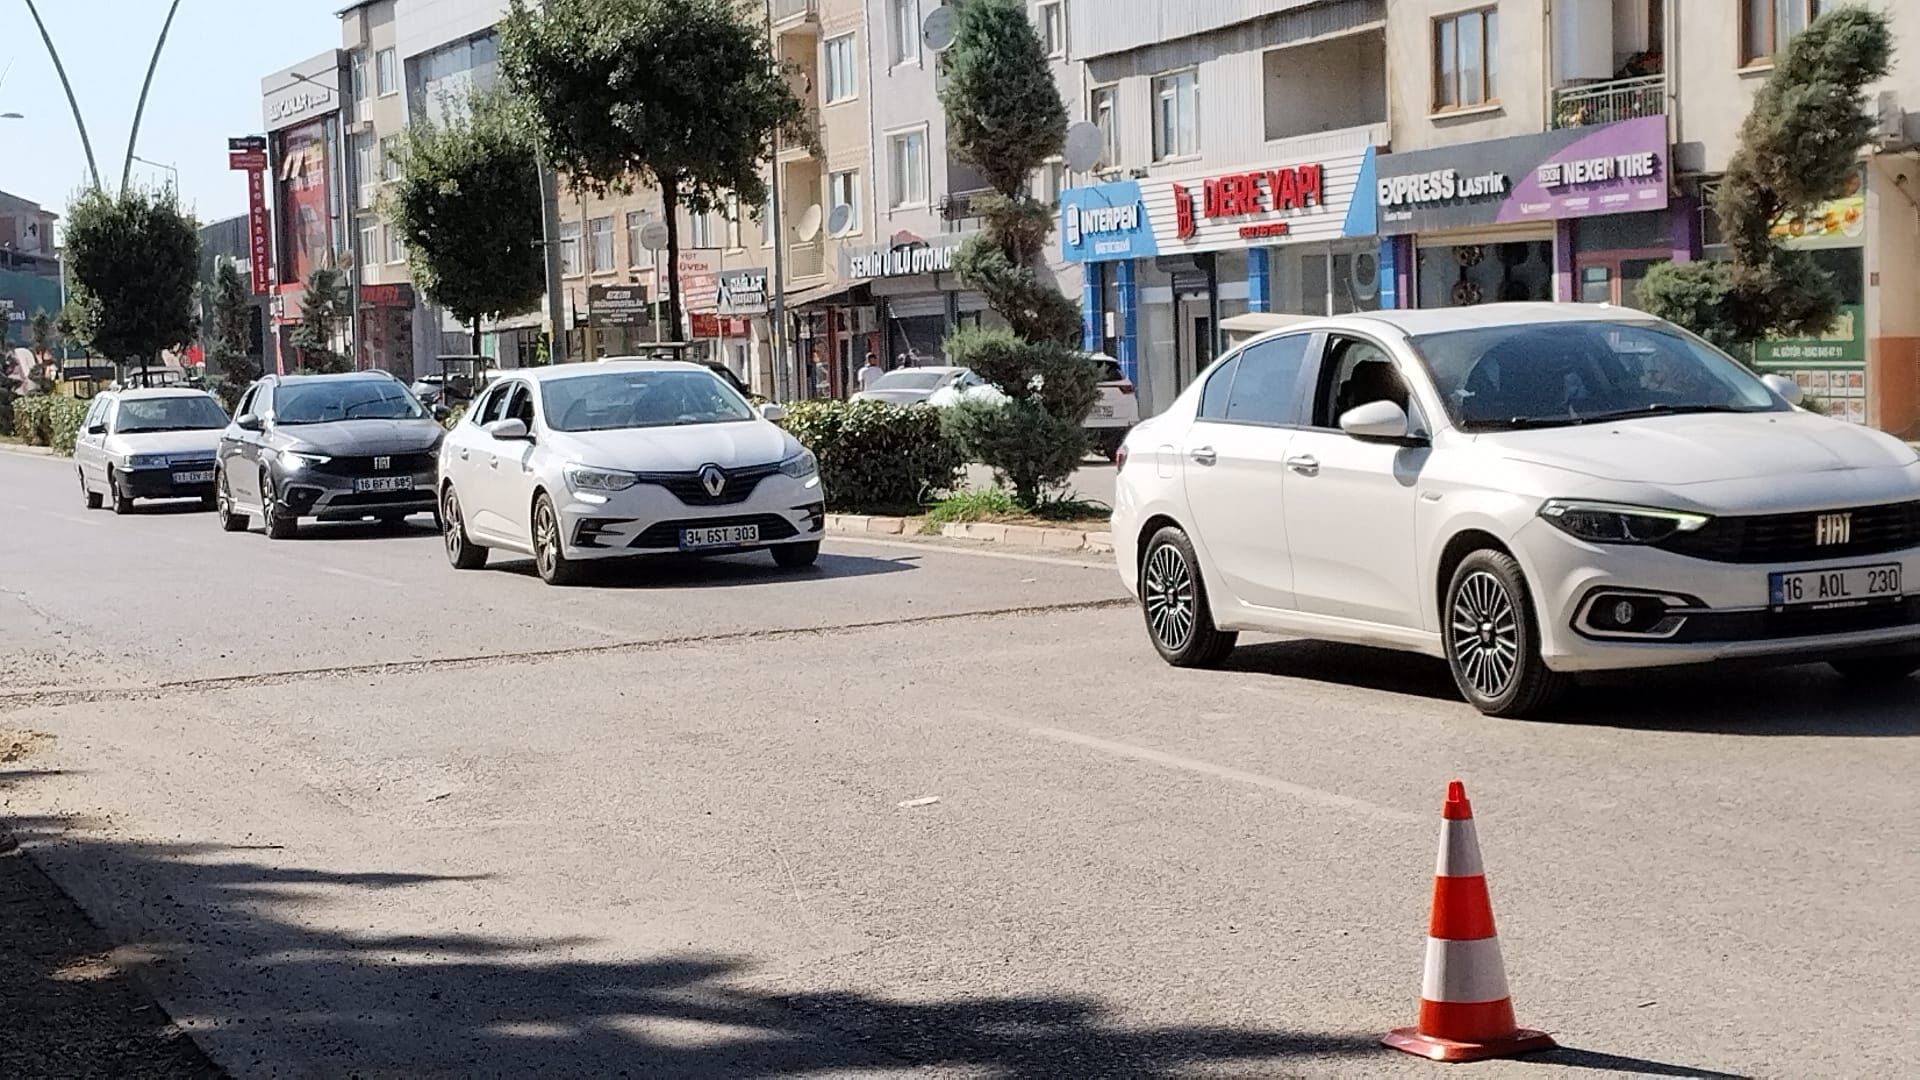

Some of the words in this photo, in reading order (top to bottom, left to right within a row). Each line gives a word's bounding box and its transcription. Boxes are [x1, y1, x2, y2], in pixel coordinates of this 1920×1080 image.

[1563, 157, 1615, 185] NEXEN
[1616, 152, 1654, 178] TIRE
[1203, 172, 1263, 218] DERE
[1266, 162, 1320, 211] YAPI
[1378, 168, 1456, 206] EXPRESS
[1458, 171, 1504, 198] LASTİK
[1081, 204, 1138, 234] INTERPEN
[687, 530, 702, 545] 34
[734, 525, 757, 541] 303
[1816, 512, 1853, 546] FIAT
[1784, 576, 1803, 601] 16
[1819, 572, 1851, 598] AOL
[1867, 568, 1898, 594] 230
